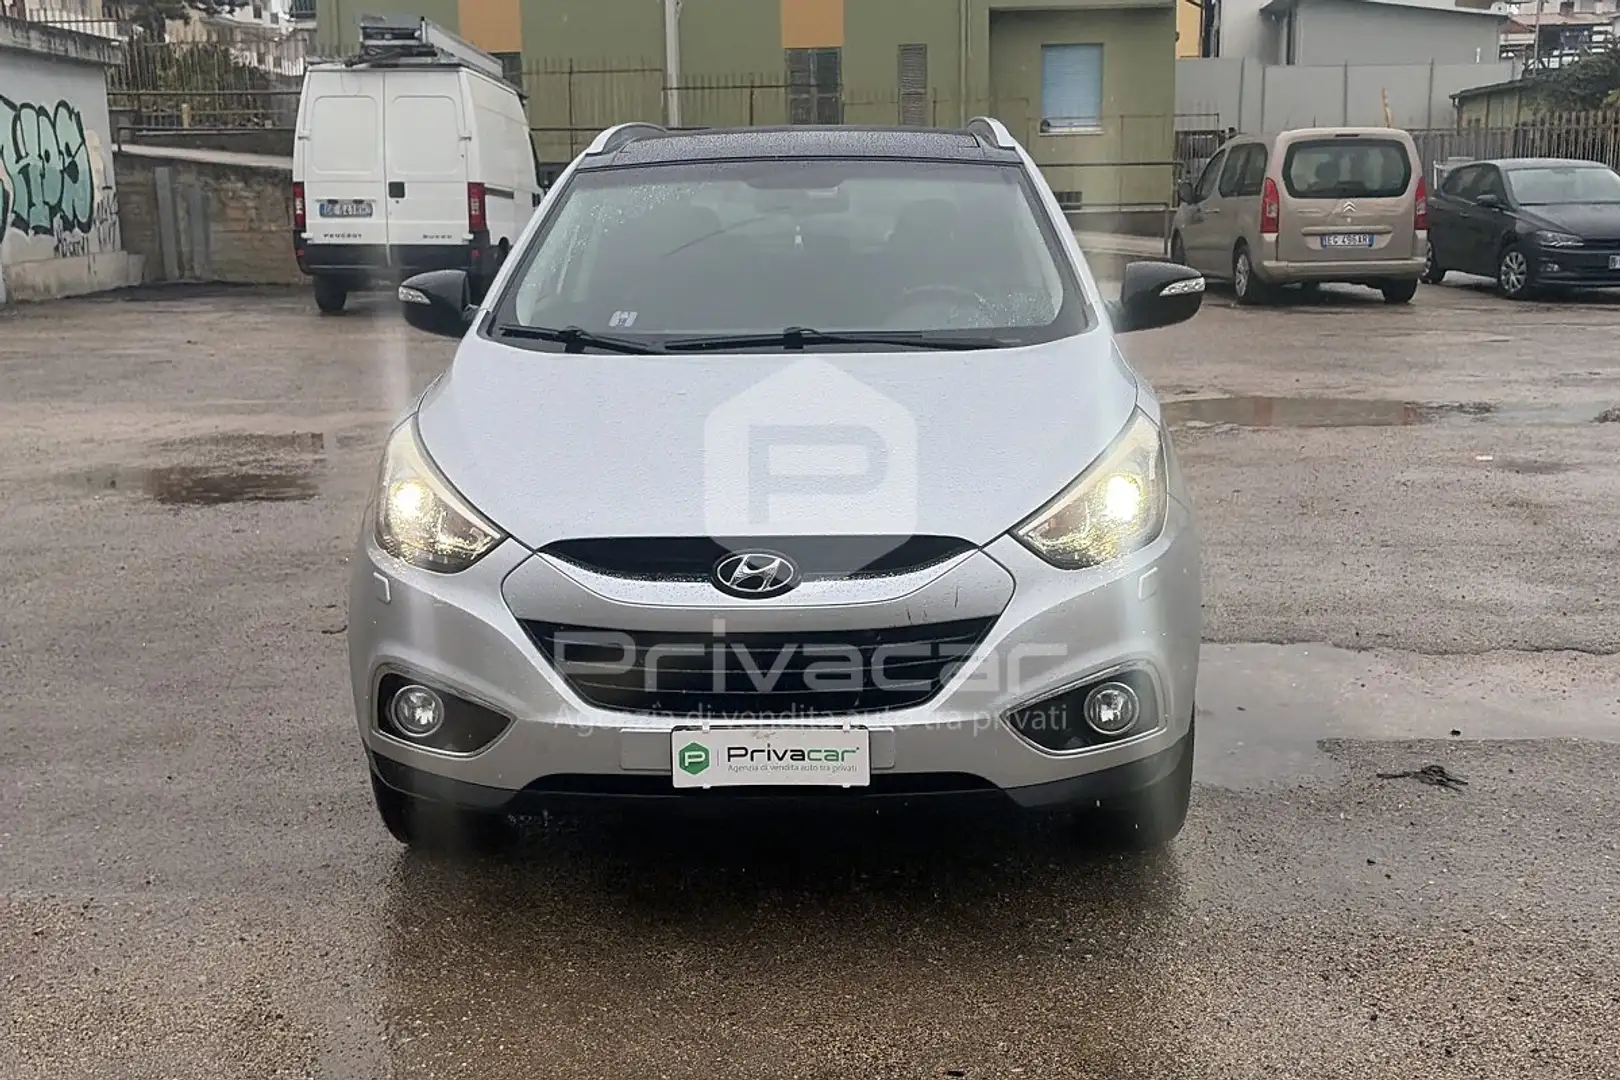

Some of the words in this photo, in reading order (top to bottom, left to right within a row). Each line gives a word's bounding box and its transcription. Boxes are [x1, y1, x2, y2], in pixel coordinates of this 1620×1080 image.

[684, 751, 705, 766] P
[727, 743, 857, 762] Privacar
[728, 764, 759, 772] Agenzia
[770, 763, 799, 771] vendita
[832, 764, 857, 773] privati
